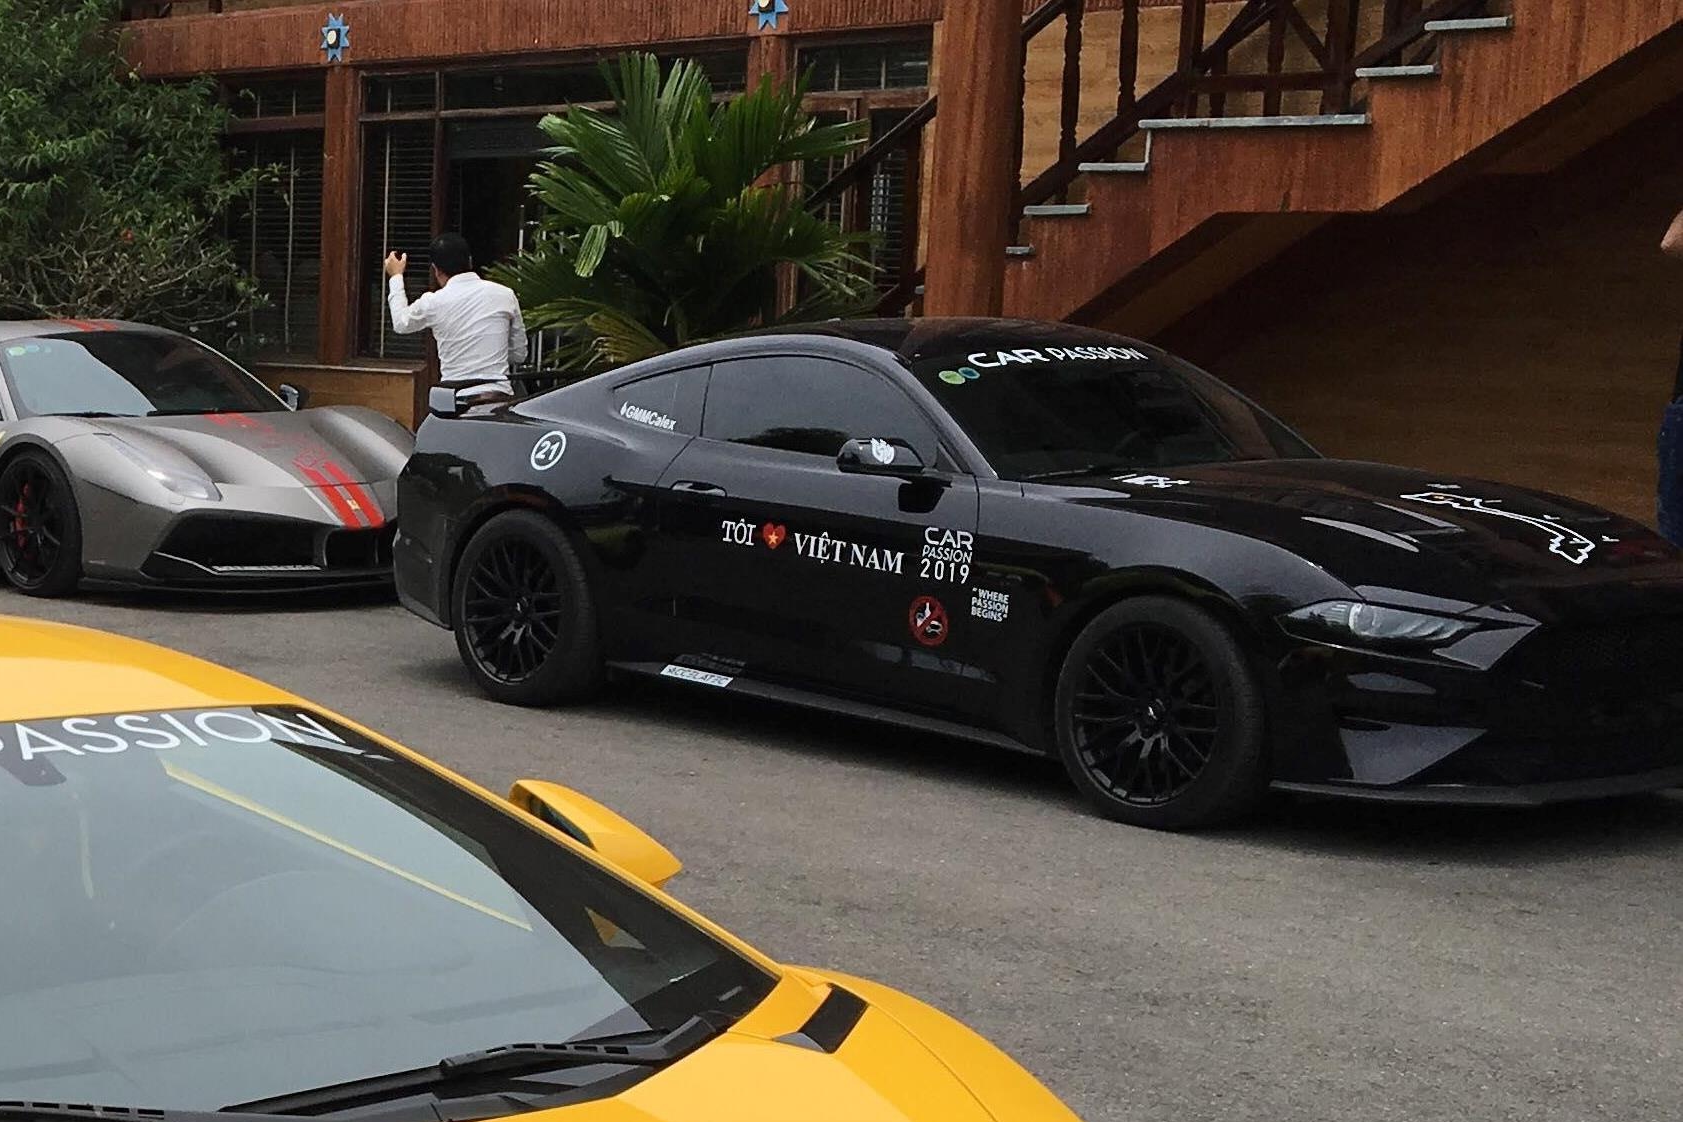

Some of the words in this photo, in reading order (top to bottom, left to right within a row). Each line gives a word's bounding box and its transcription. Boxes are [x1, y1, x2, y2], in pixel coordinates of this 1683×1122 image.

[968, 349, 1050, 368] CAR
[1045, 347, 1149, 361] PASSION
[535, 440, 560, 461] 21
[721, 518, 757, 546] TÔI
[794, 531, 847, 564] VIỆT
[850, 543, 905, 574] NAM
[924, 526, 974, 551] CAR
[921, 544, 973, 564] PASSION
[919, 558, 970, 584] 2019
[971, 596, 1009, 614] PASSION
